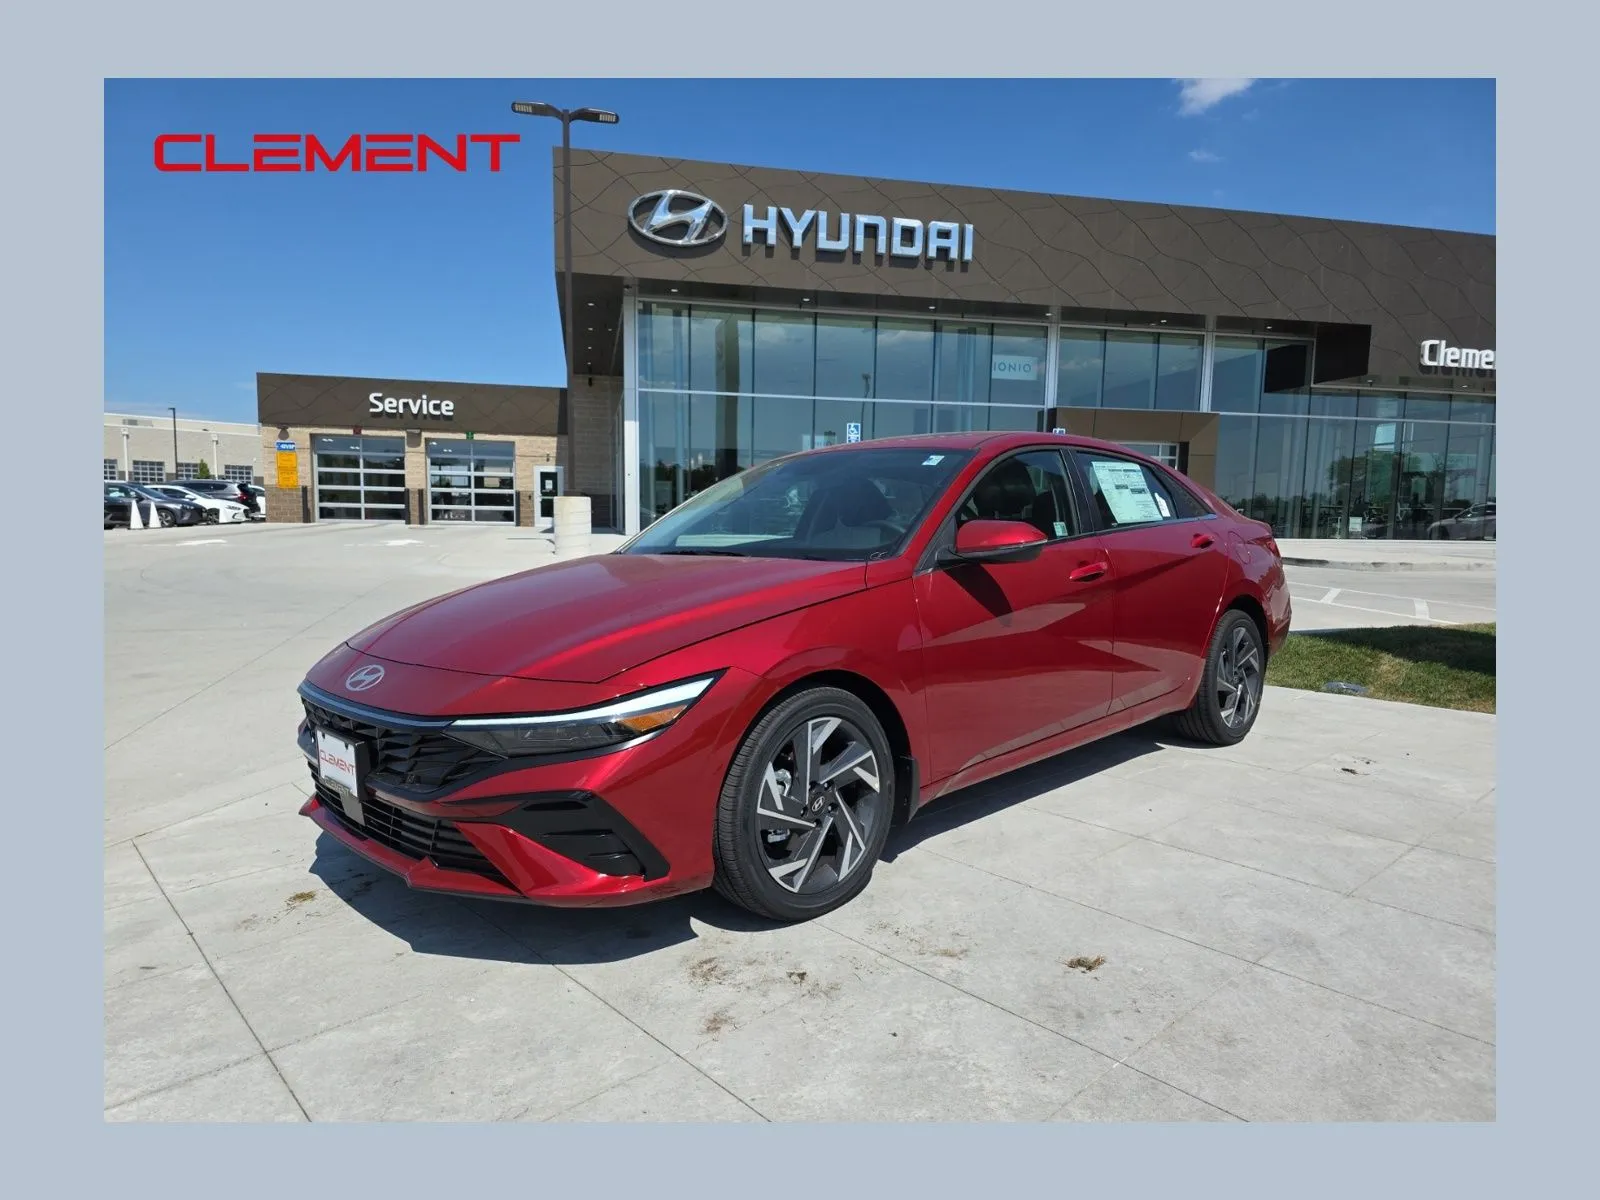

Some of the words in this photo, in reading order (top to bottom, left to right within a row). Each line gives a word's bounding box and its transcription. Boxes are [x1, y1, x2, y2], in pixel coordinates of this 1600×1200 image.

[743, 203, 974, 263] HYUNDAI
[1420, 339, 1496, 370] Cleme
[368, 392, 455, 416] Service
[319, 749, 355, 776] CLEMENT
